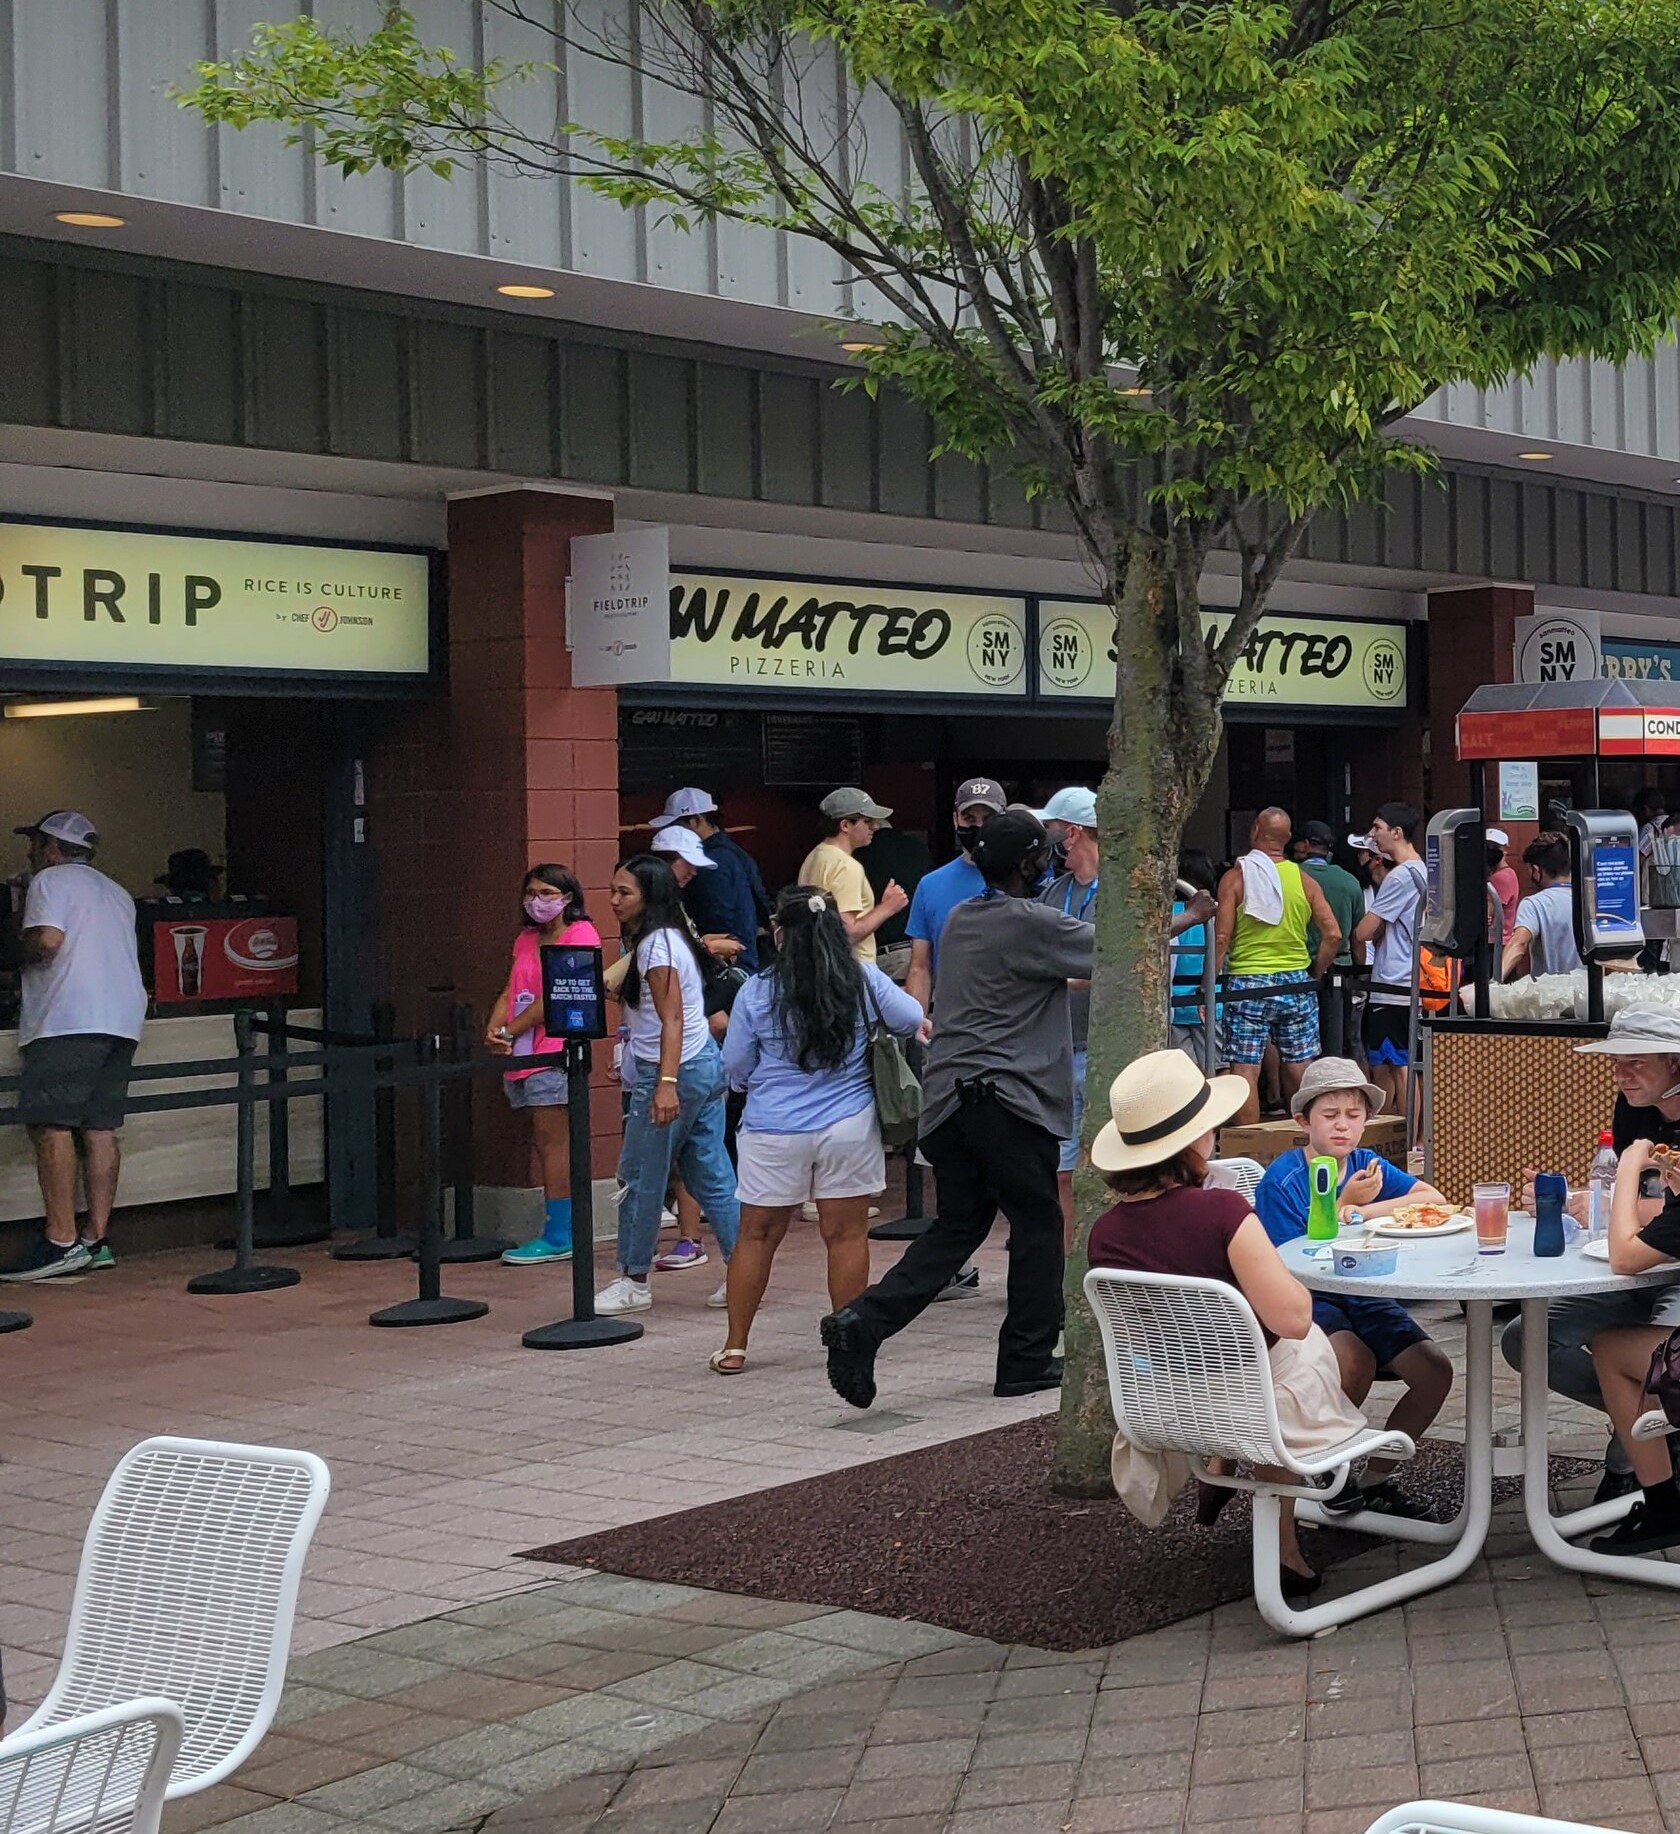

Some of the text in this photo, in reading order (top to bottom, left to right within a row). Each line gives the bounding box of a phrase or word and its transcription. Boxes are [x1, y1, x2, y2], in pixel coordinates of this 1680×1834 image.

[0, 565, 222, 626] TRIP
[244, 578, 402, 600] RICE IS CULTURE
[593, 596, 649, 612] FIELDTRIP
[732, 592, 952, 660] MATTEO
[982, 631, 1009, 649] SM
[1053, 635, 1078, 652] SM
[982, 649, 1010, 667] NY
[1053, 652, 1078, 669] NY
[1374, 653, 1394, 669] SM
[1540, 641, 1576, 664] SM
[730, 656, 846, 679] PIZZERIA
[1374, 669, 1394, 684] NY
[1540, 663, 1576, 682] NY
[1227, 678, 1278, 695] ZERIA
